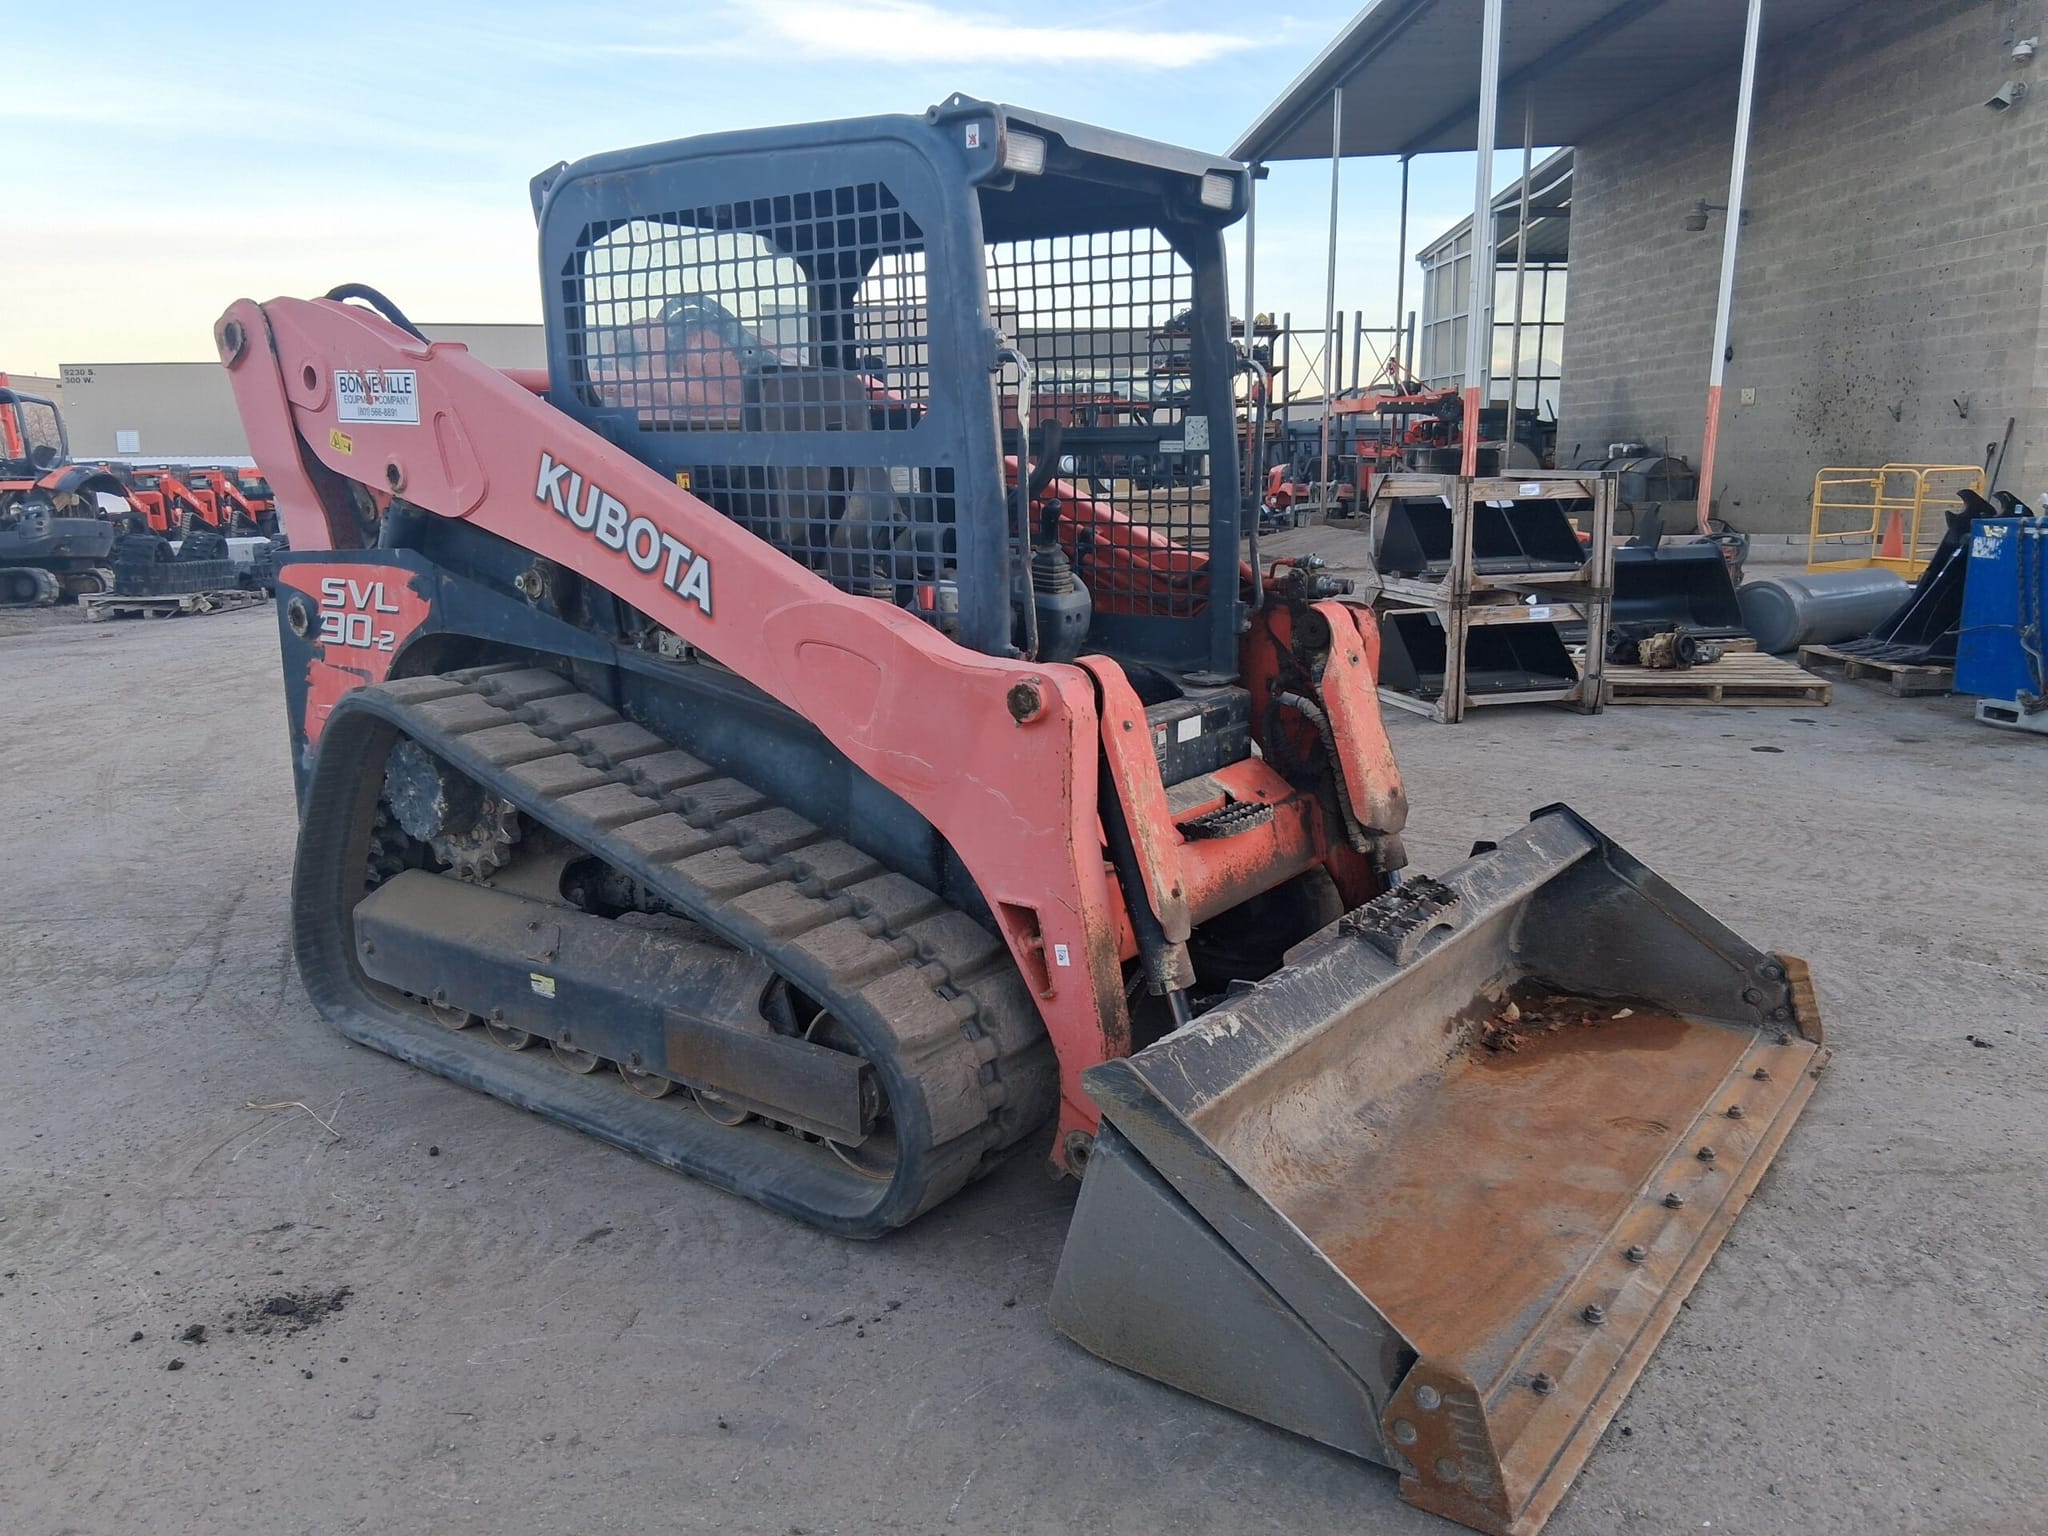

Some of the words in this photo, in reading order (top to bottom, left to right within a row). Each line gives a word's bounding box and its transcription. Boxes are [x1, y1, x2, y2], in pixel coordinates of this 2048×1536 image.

[340, 376, 412, 393] BONNEVILLE
[344, 394, 379, 404] EQUIPMT
[379, 395, 409, 405] COMPANY
[535, 451, 713, 618] KUBOTA
[320, 577, 399, 613] SVL
[320, 610, 395, 652] 90-2
